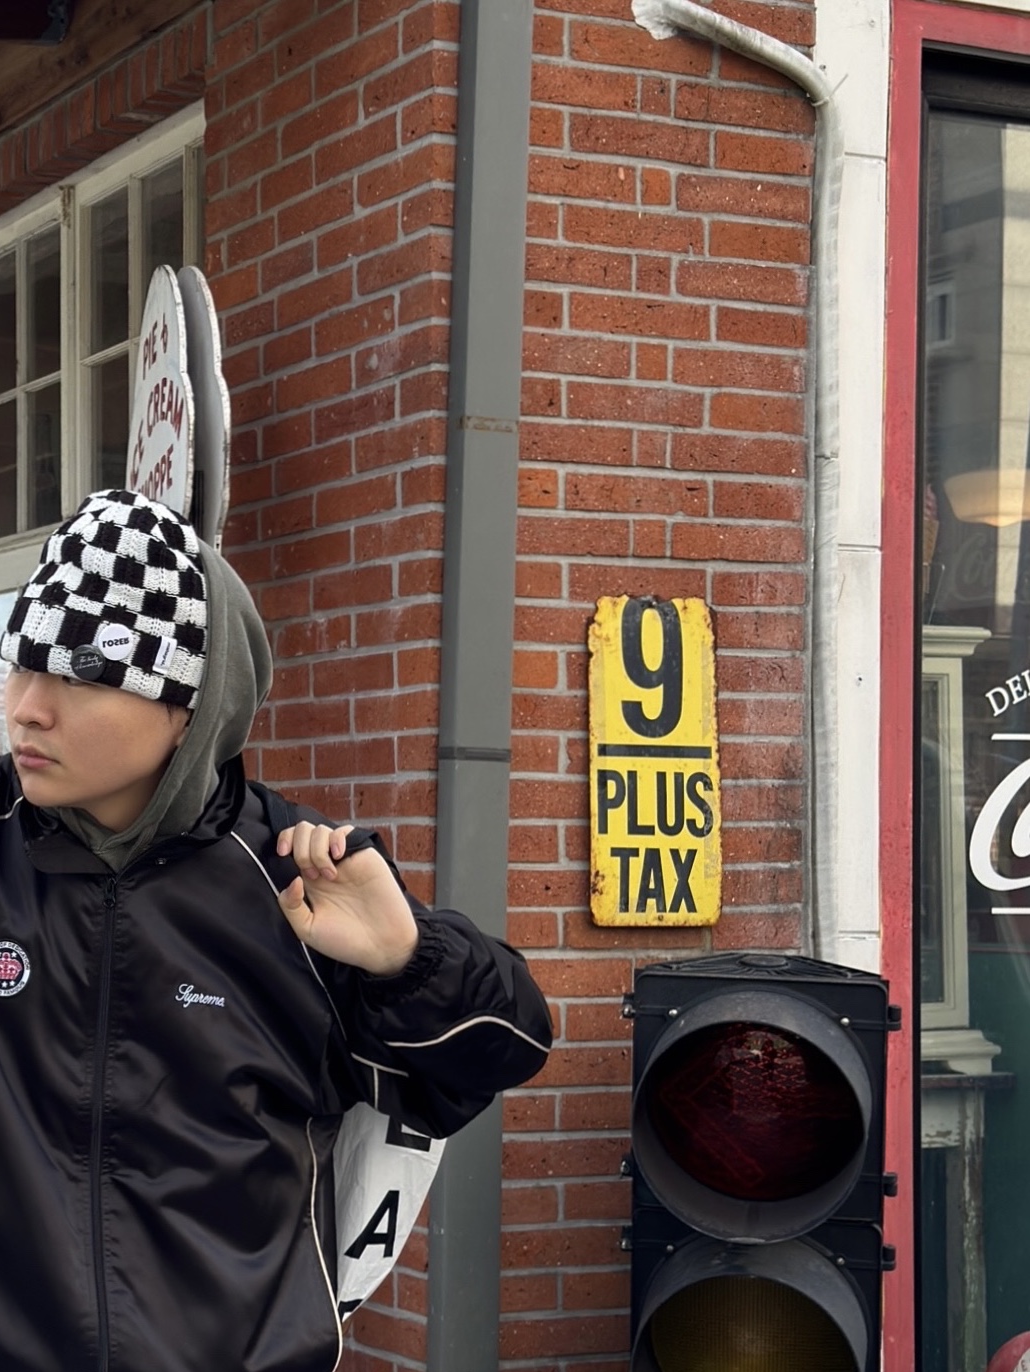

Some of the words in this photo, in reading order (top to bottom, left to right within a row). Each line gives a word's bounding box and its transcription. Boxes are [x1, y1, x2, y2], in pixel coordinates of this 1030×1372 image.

[142, 319, 158, 381] PIE
[146, 377, 184, 441] CREAM
[621, 598, 683, 739] 9
[597, 769, 714, 838] PLUS
[611, 847, 698, 914] TAX
[174, 983, 225, 1008] Supreme
